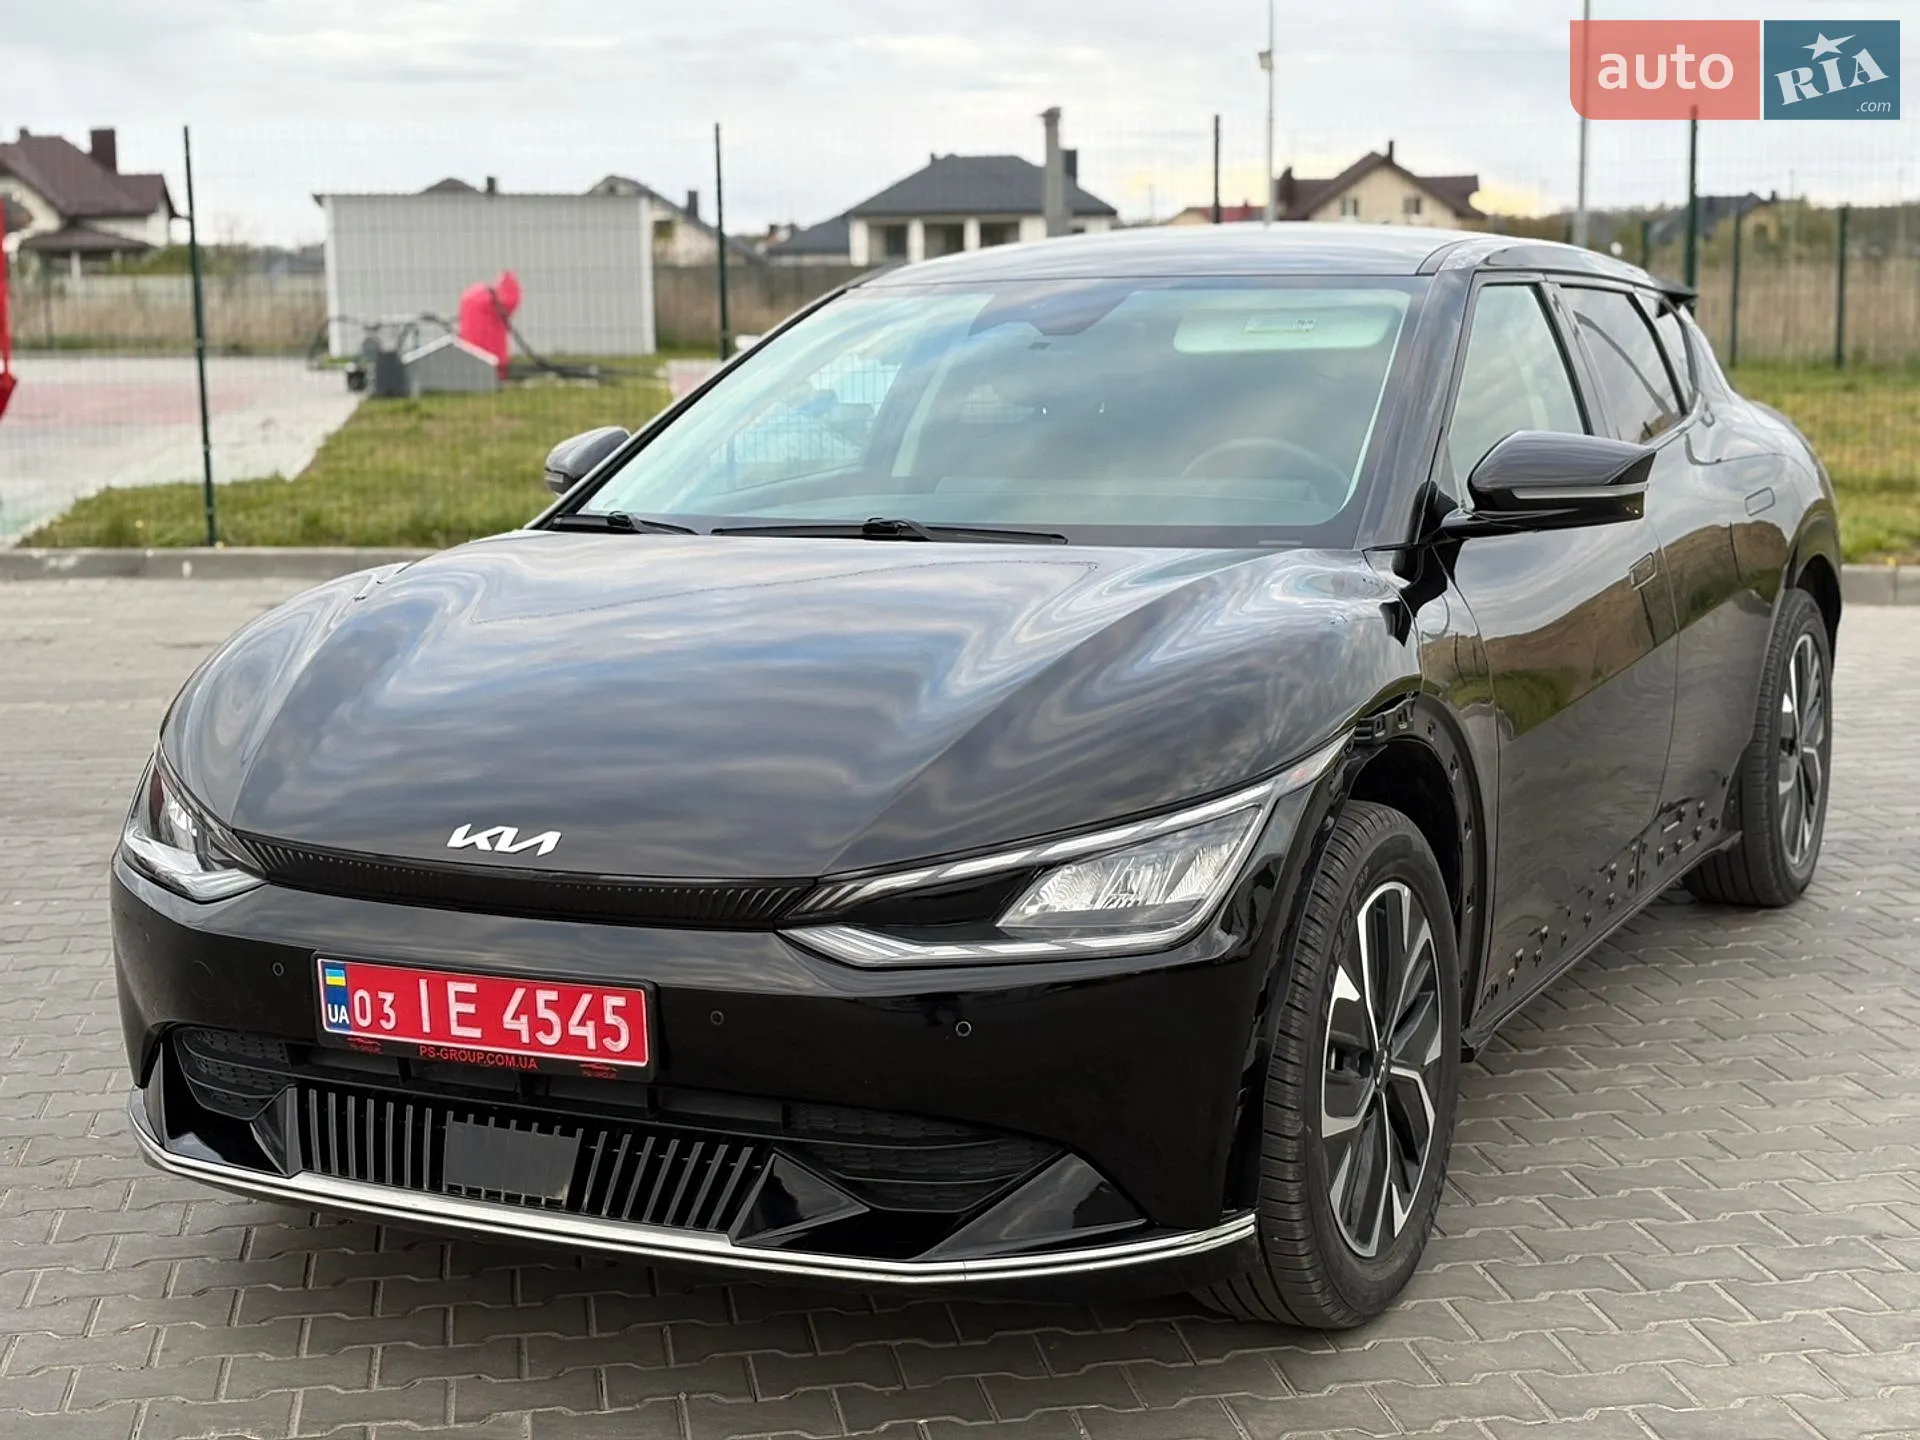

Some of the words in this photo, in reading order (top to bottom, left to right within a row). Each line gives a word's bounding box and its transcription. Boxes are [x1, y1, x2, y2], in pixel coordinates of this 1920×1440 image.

[446, 823, 561, 857] KIA
[327, 1003, 350, 1025] UA
[353, 988, 397, 1031] 03
[418, 978, 482, 1038] IE
[502, 987, 630, 1052] 4545
[418, 1044, 538, 1070] PS-GROUP.COM.UA
